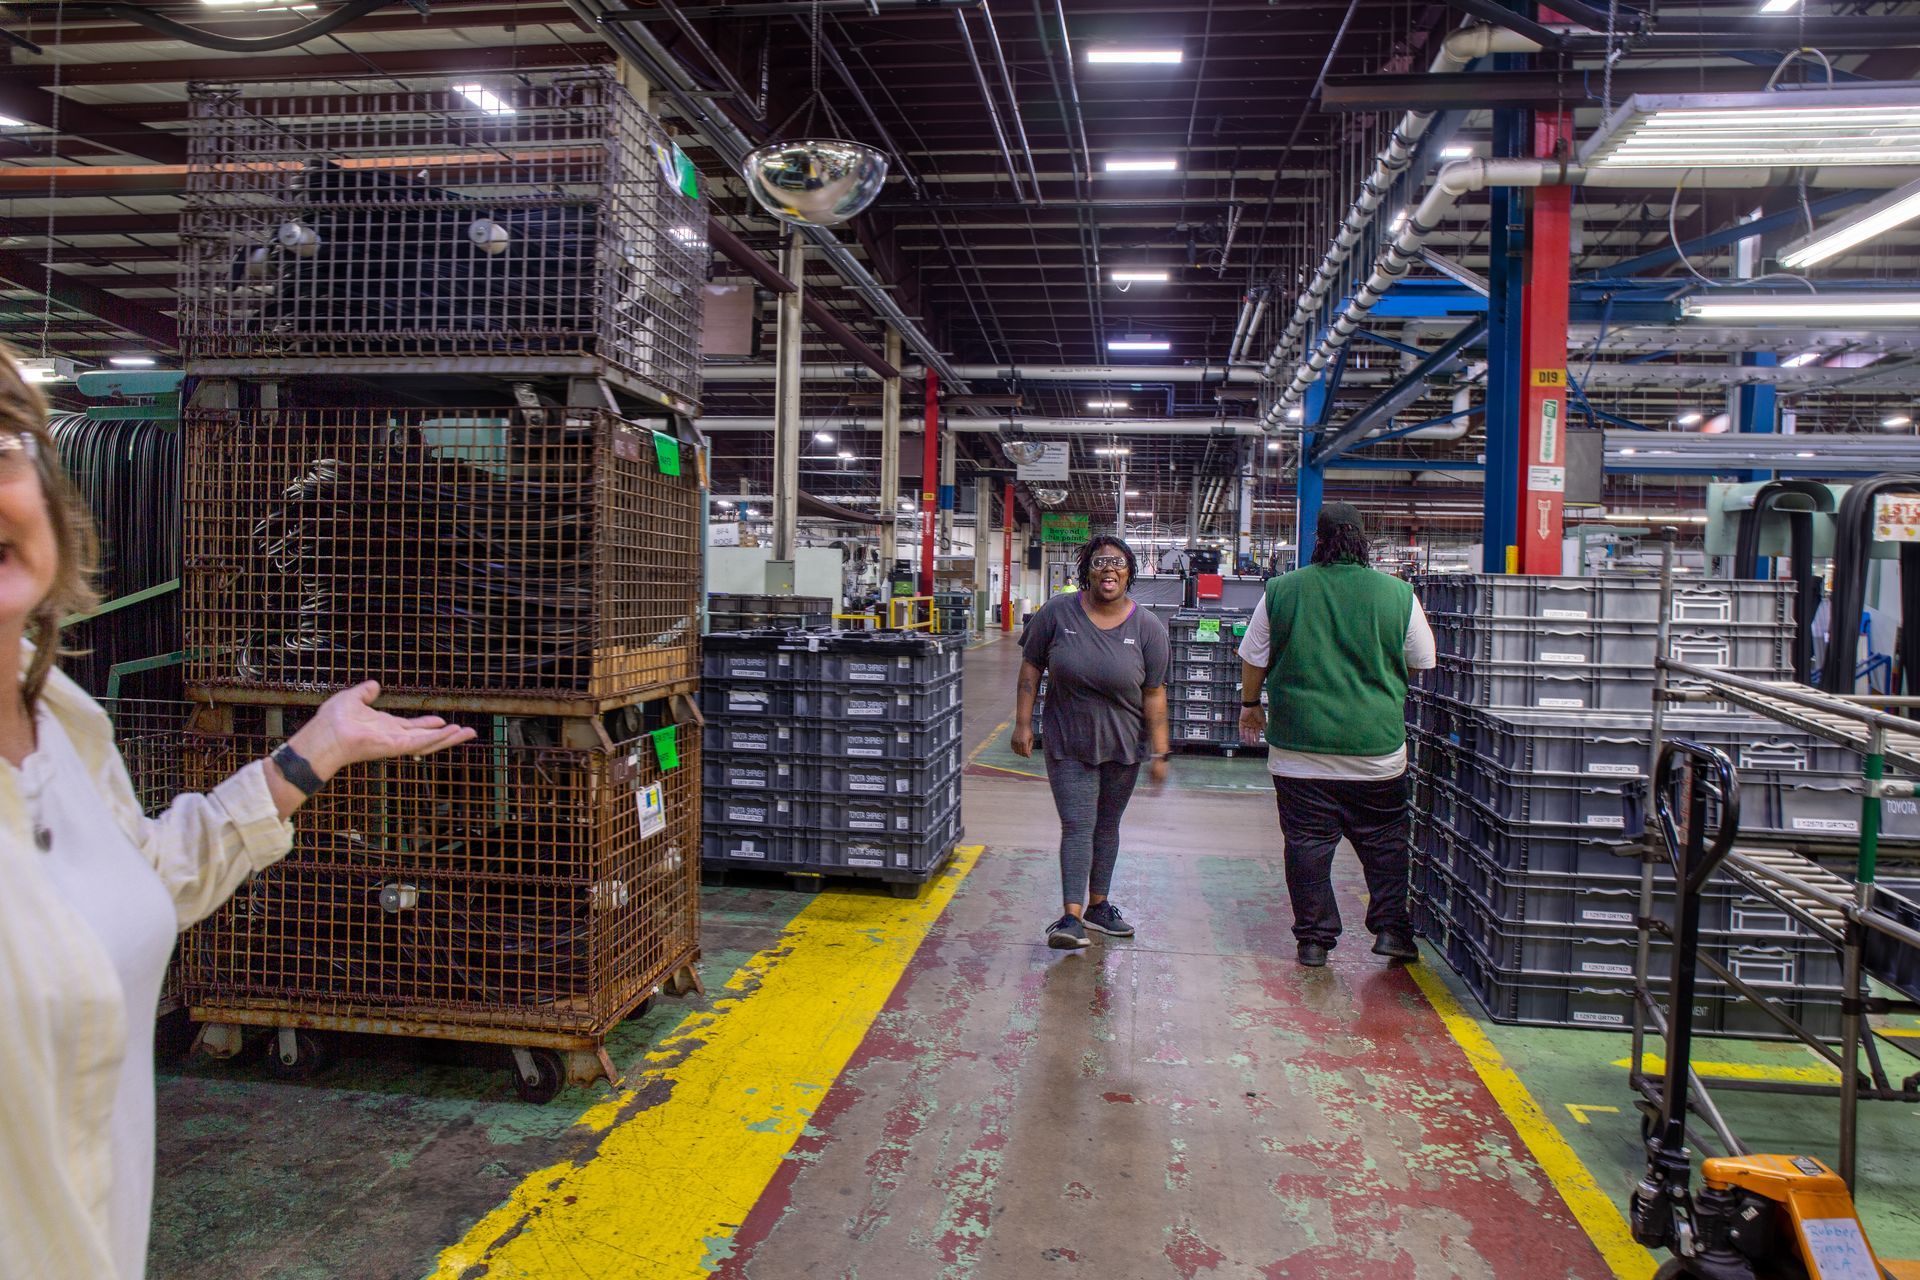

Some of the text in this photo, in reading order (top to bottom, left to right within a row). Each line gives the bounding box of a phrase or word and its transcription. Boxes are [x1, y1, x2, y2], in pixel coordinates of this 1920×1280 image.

[1539, 372, 1558, 383] D19
[1886, 800, 1918, 815] TOYOTA
[1807, 1224, 1857, 1238] Rubber
